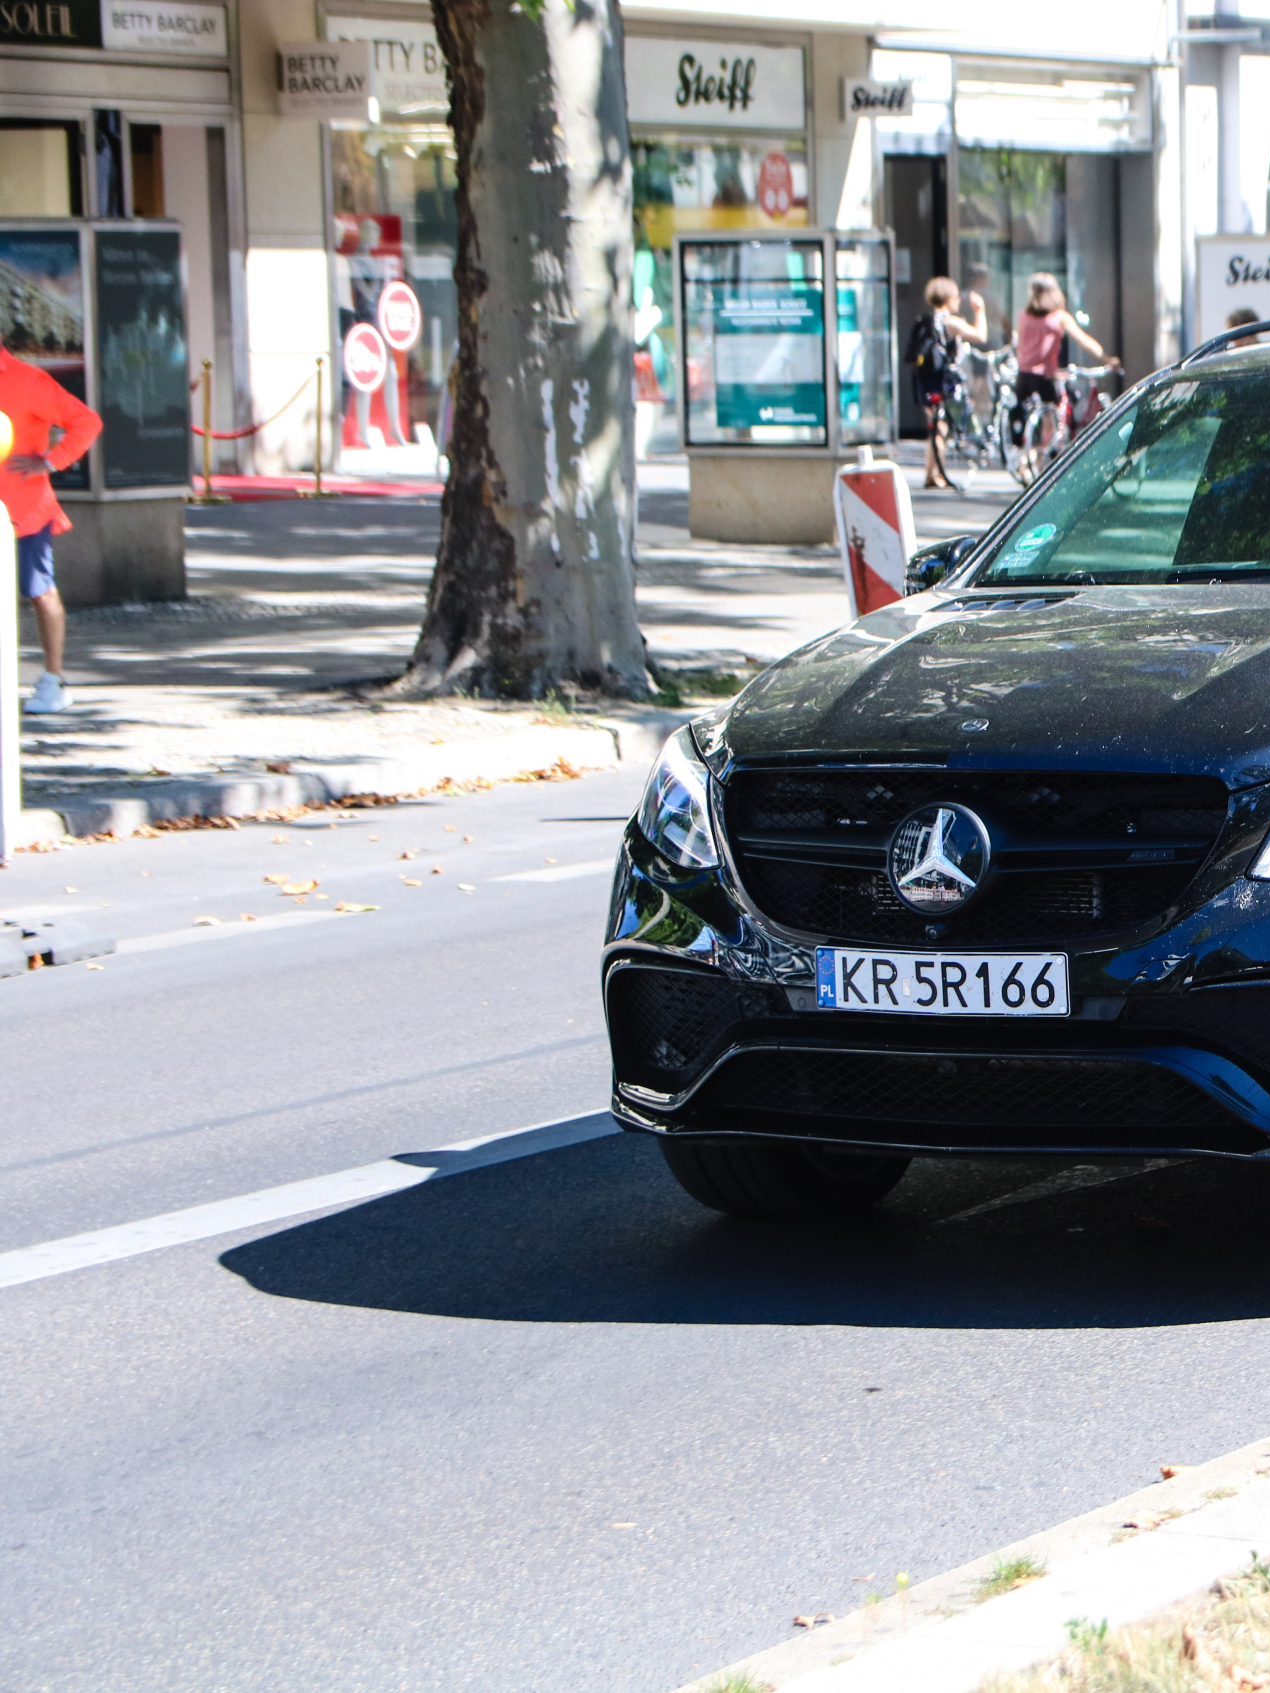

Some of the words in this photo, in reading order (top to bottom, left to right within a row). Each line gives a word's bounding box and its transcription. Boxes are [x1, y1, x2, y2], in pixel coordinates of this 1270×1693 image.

[111, 11, 151, 31] BETTY
[157, 15, 217, 36] BARCLAY
[287, 55, 340, 74] BETTY
[288, 74, 366, 94] BARCLAY
[676, 54, 757, 113] Steiff
[851, 86, 908, 113] Steiff
[820, 984, 834, 998] PL
[841, 956, 899, 1005] KR
[914, 960, 1056, 1008] 5R166
